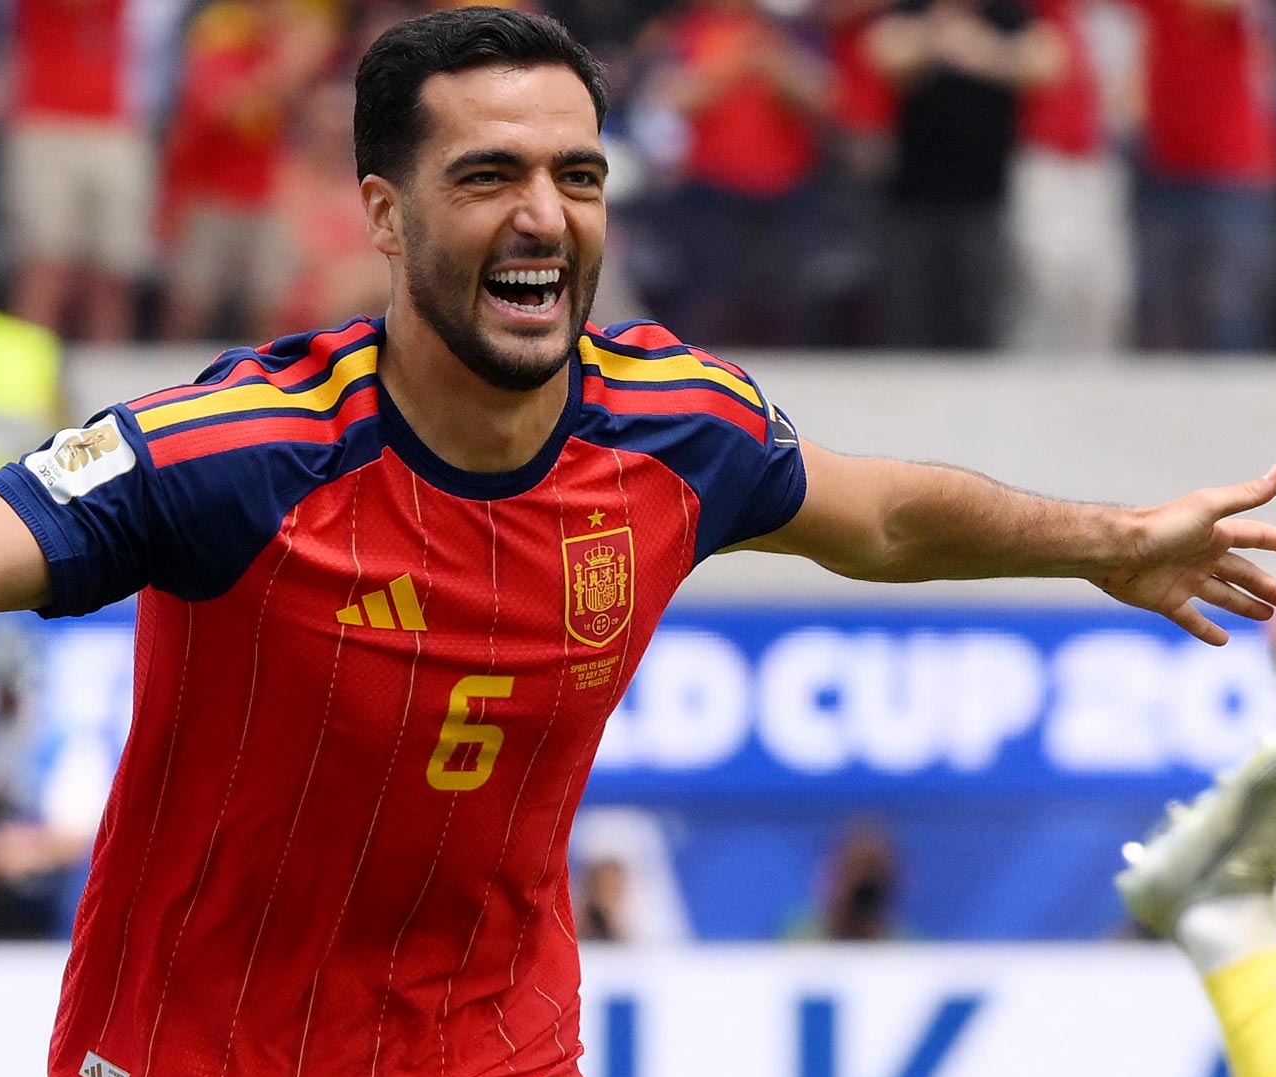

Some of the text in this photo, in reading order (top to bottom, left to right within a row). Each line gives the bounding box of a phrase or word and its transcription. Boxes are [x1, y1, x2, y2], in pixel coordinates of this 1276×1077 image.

[426, 675, 515, 791] 6
[575, 681, 587, 690] LOS
[756, 626, 1044, 773] CUP
